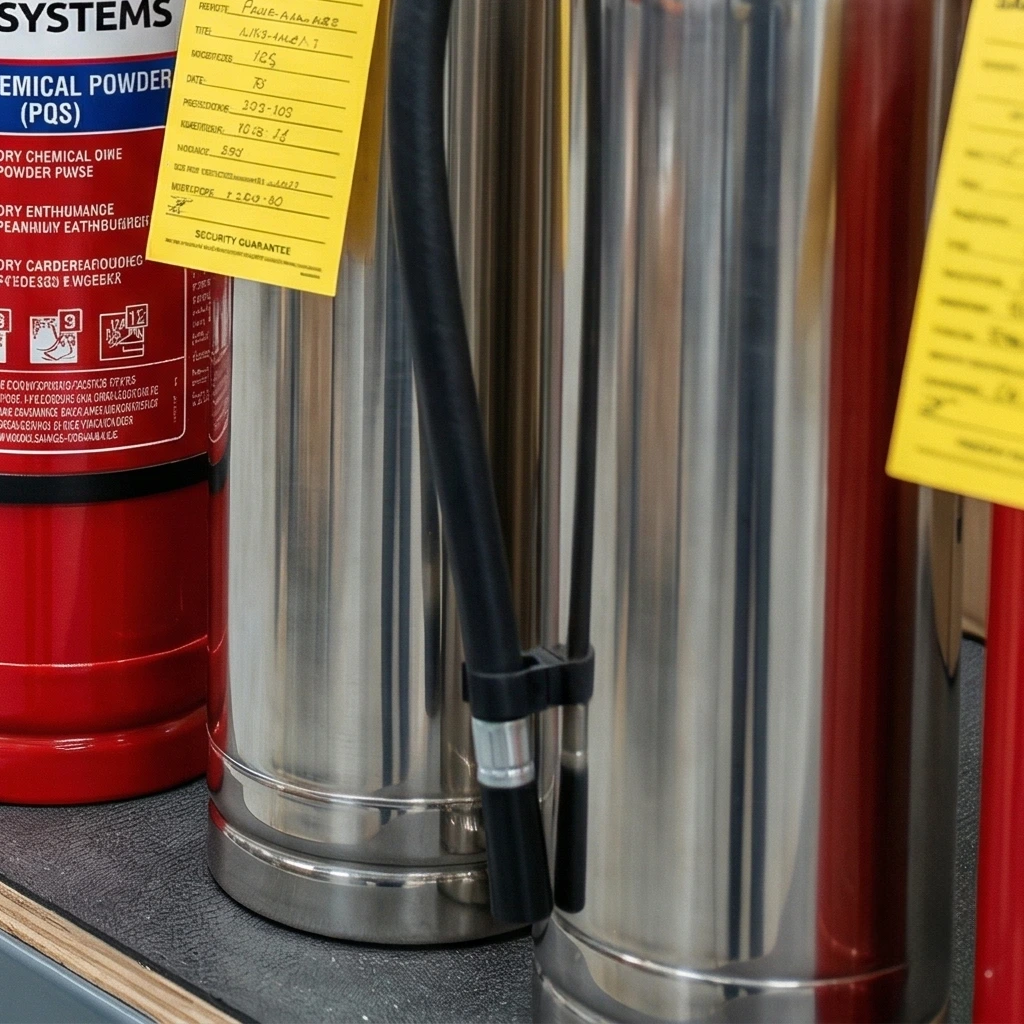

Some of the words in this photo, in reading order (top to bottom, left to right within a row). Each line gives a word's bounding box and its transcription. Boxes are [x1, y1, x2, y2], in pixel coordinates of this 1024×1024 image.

[88, 68, 172, 96] POWDER
[20, 101, 81, 128] (PQS)
[26, 149, 92, 164] CHEMICAL
[194, 229, 238, 246] SECURITY
[238, 237, 292, 256] GUARANTEE
